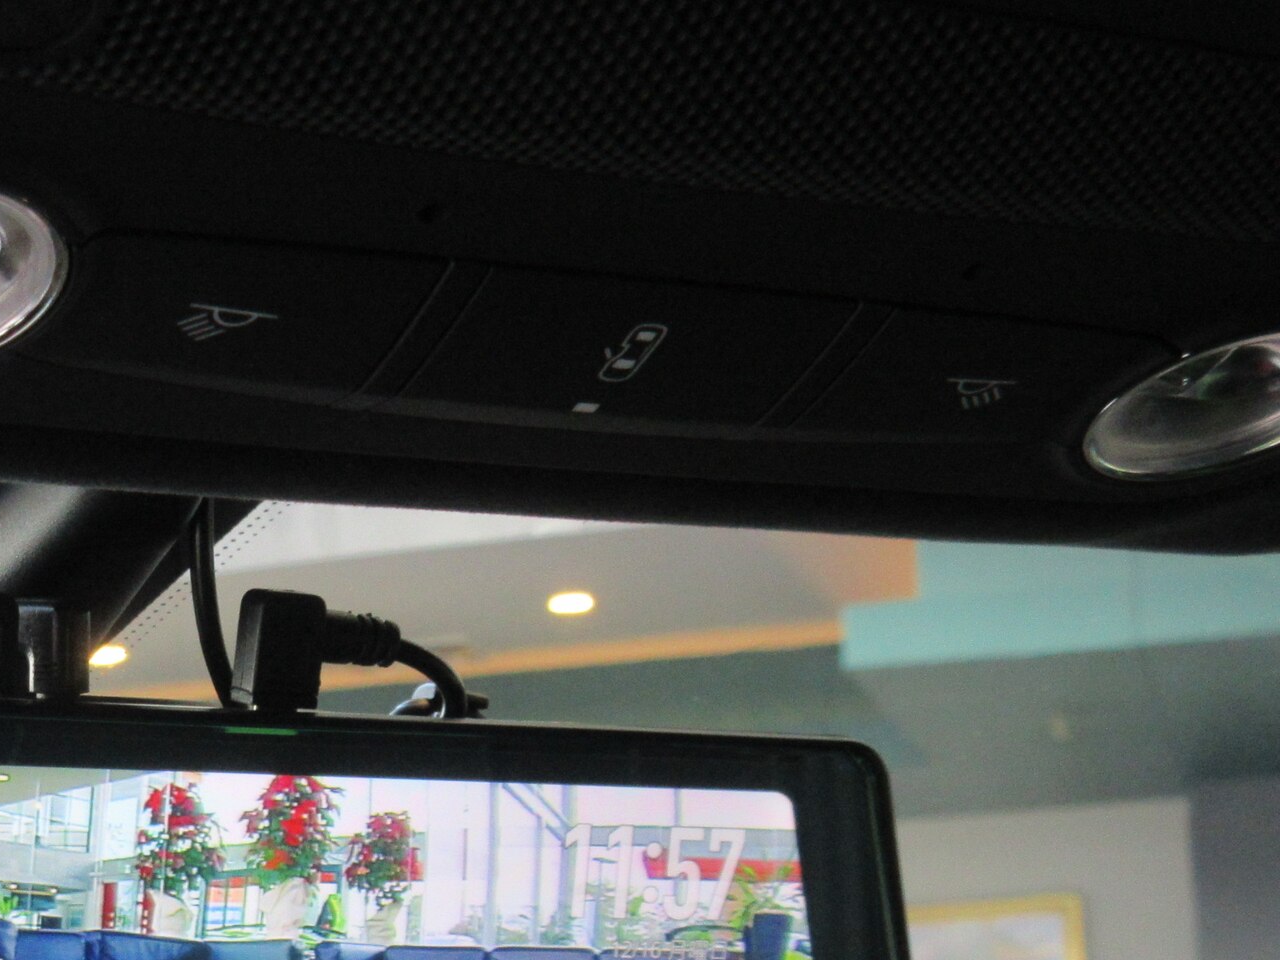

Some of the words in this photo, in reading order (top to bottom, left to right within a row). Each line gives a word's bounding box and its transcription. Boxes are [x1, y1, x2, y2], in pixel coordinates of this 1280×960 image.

[564, 823, 746, 921] 11:57
[667, 939, 728, 960] 月曜日
